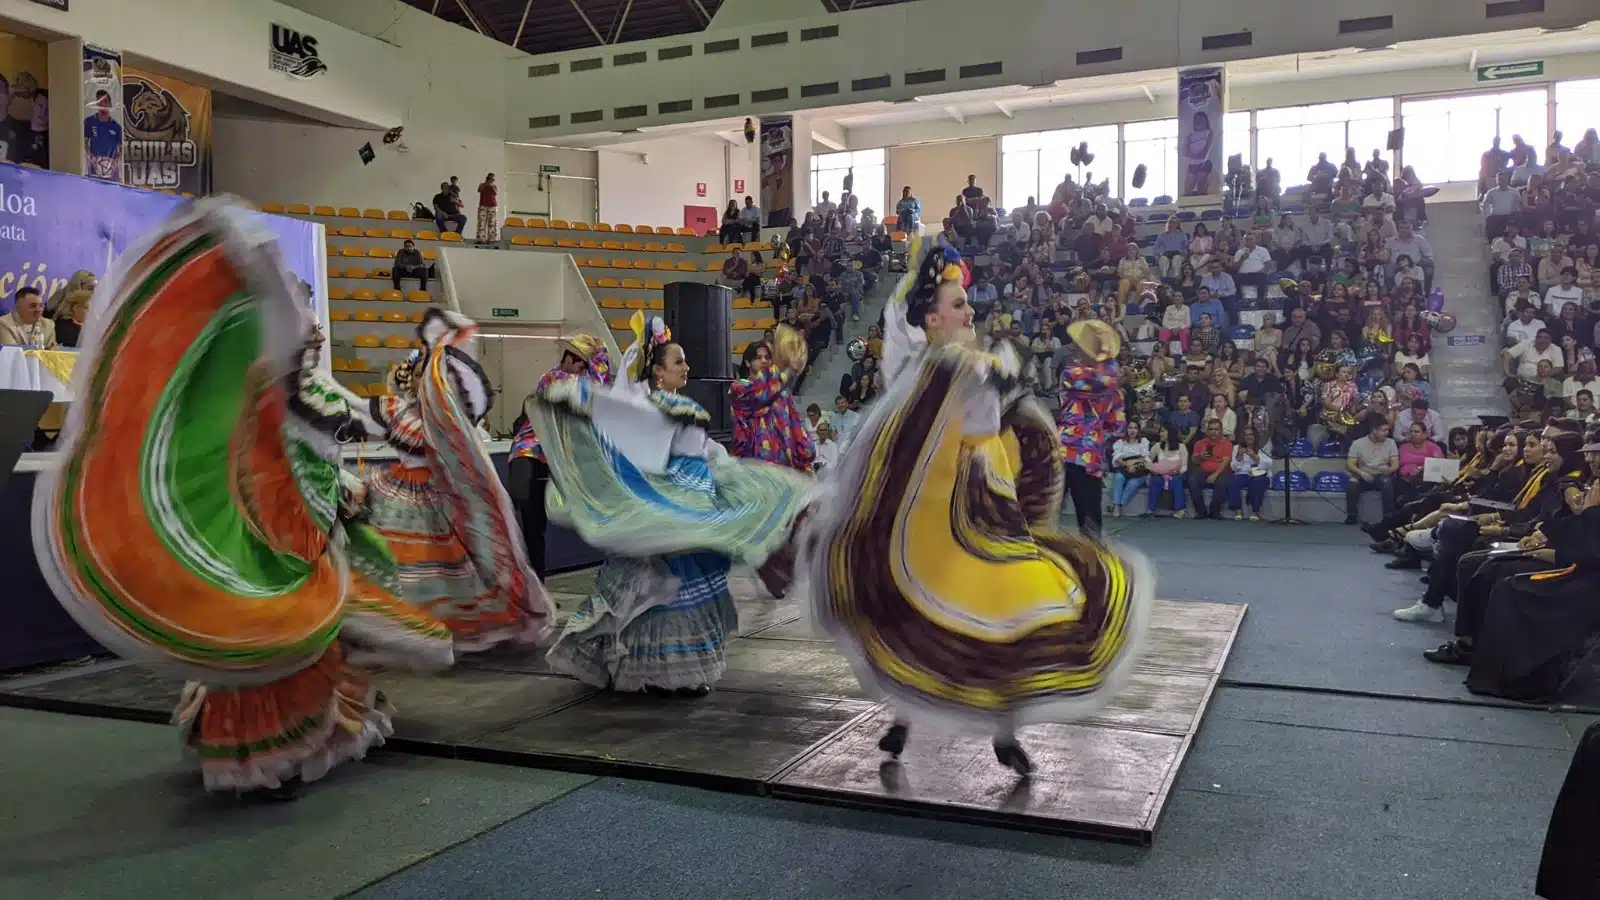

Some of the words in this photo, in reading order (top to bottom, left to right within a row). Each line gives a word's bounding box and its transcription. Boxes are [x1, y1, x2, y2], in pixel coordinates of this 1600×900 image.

[272, 23, 318, 58] UAS
[132, 161, 177, 185] UAS
[0, 223, 26, 242] ata
